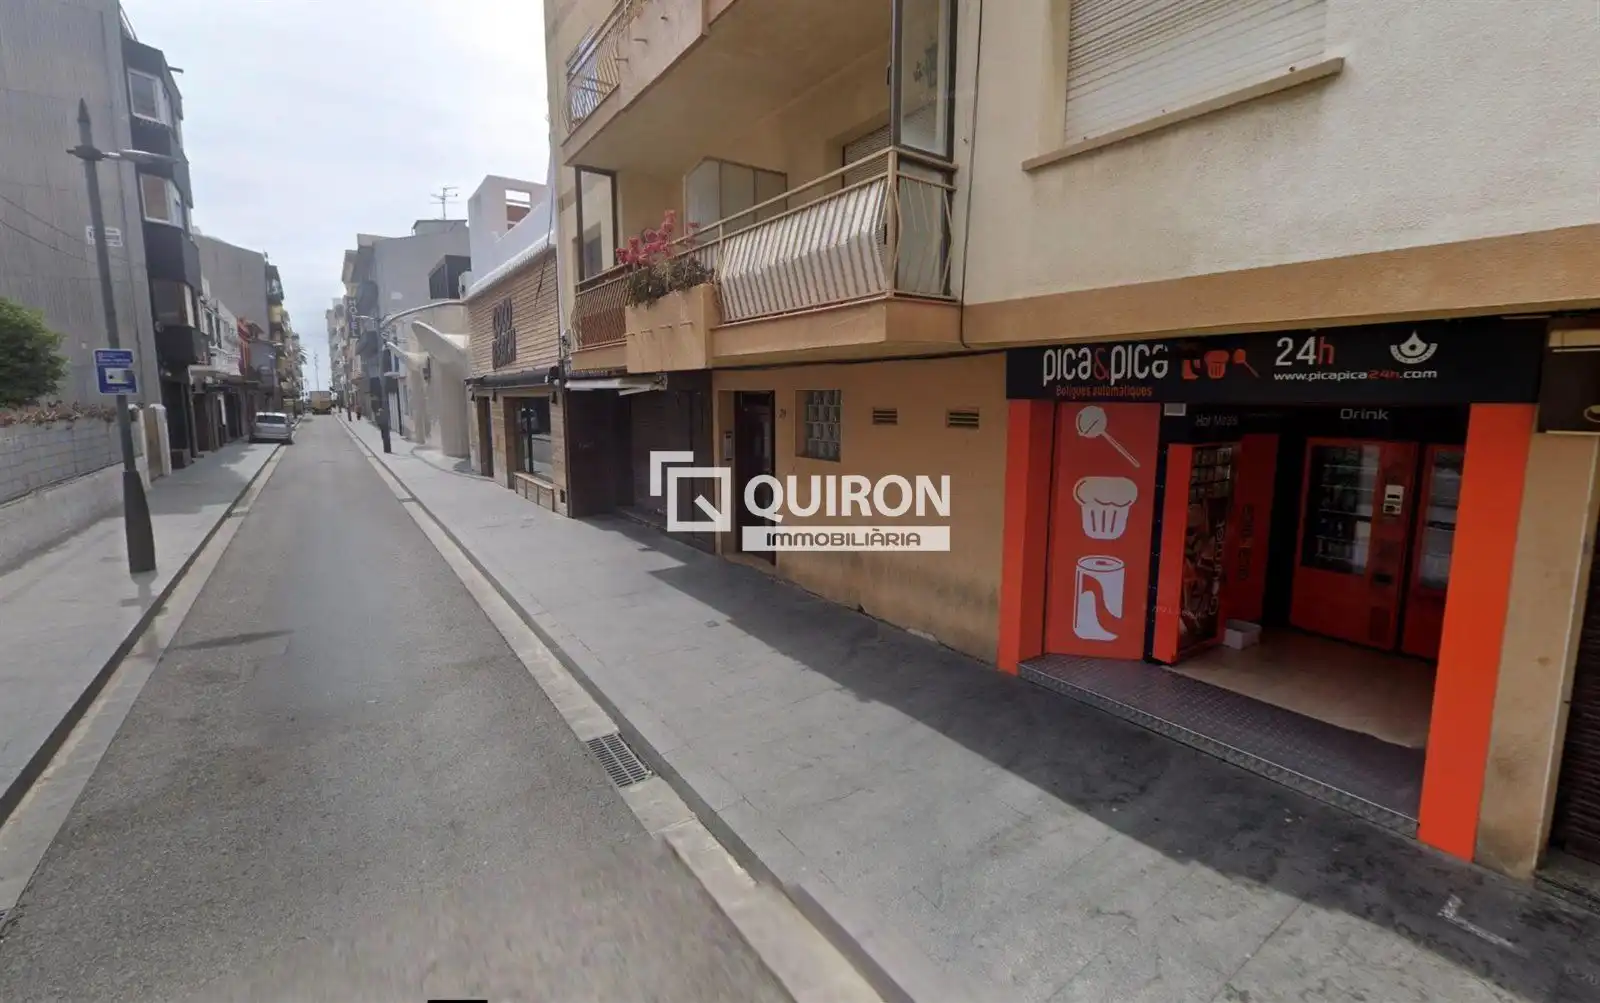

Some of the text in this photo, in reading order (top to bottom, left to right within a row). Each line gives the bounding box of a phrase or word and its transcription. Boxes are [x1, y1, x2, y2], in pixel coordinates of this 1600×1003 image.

[1275, 336, 1335, 366] 24h
[1273, 370, 1438, 382] www.picapica24h.com
[1056, 384, 1091, 399] Botigues
[1340, 408, 1389, 420] Drink
